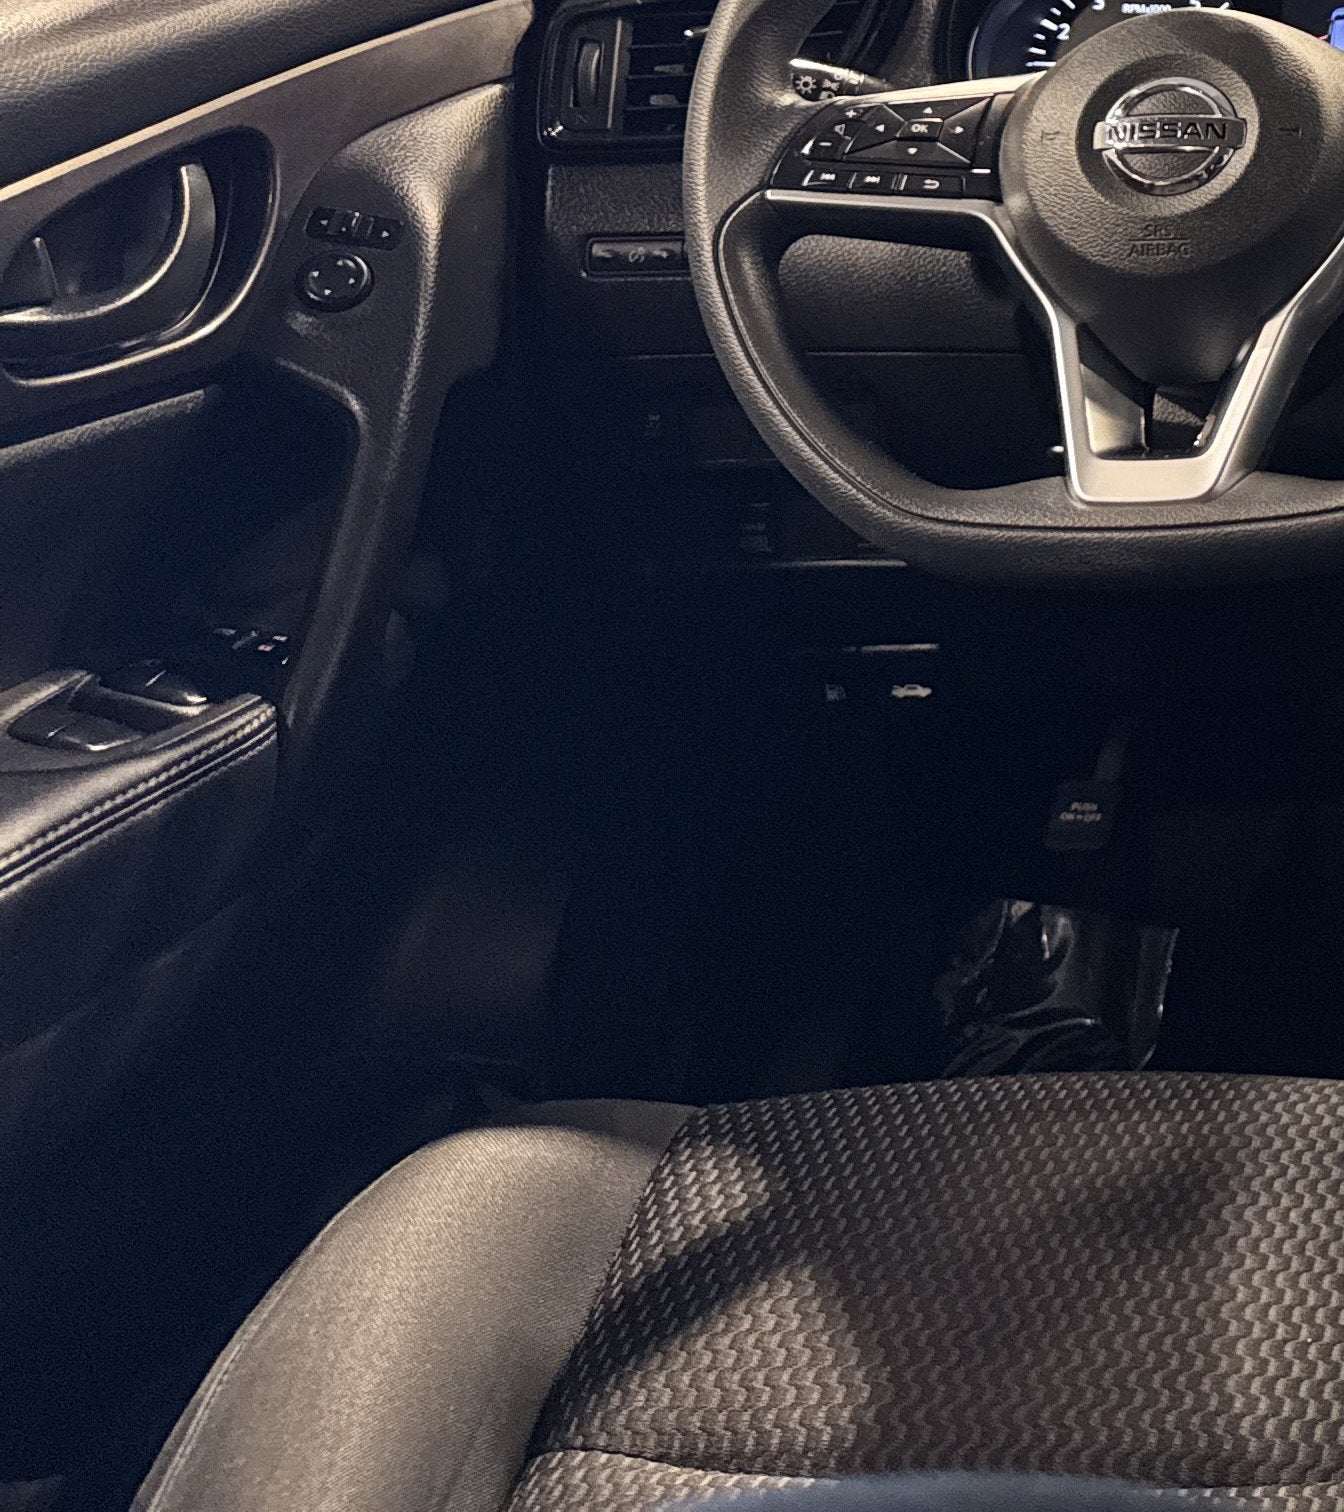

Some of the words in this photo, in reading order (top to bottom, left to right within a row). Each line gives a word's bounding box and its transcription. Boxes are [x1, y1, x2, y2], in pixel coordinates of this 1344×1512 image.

[1056, 23, 1071, 40] 2
[911, 123, 929, 134] OK
[1108, 121, 1228, 140] NISSAN
[1142, 222, 1175, 238] SRS
[1127, 243, 1192, 259] AIRBAG
[1070, 801, 1098, 811] PUSH
